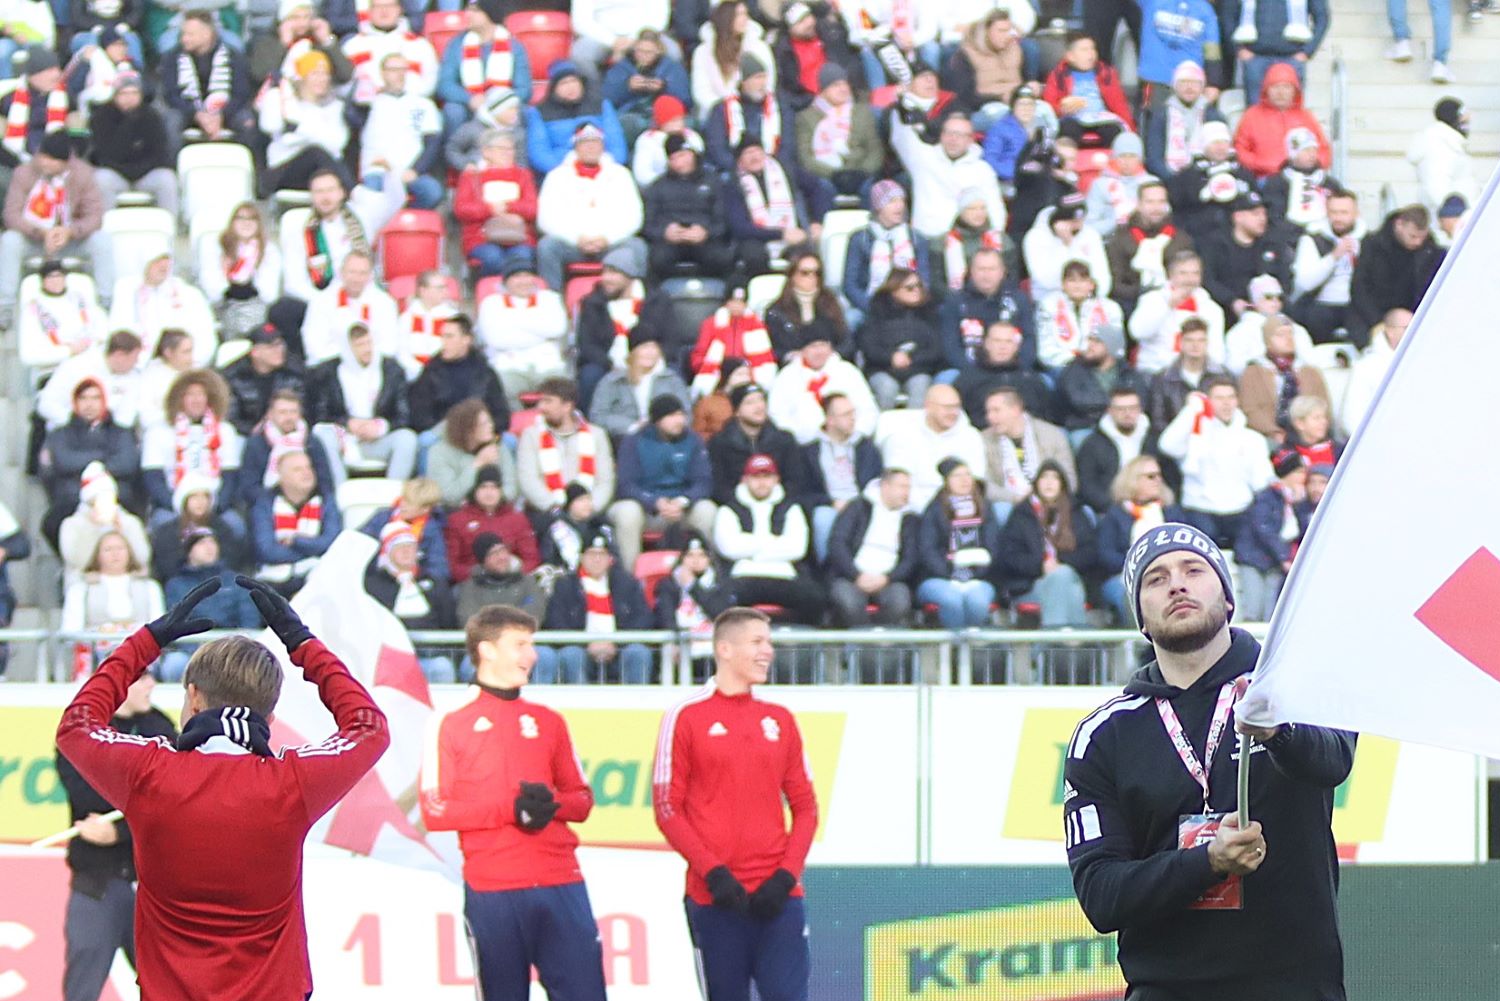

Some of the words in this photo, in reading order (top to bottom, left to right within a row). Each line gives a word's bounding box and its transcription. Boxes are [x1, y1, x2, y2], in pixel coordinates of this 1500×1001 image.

[343, 912, 382, 986] 1
[436, 912, 649, 986] LA
[905, 940, 1117, 994] Kram
